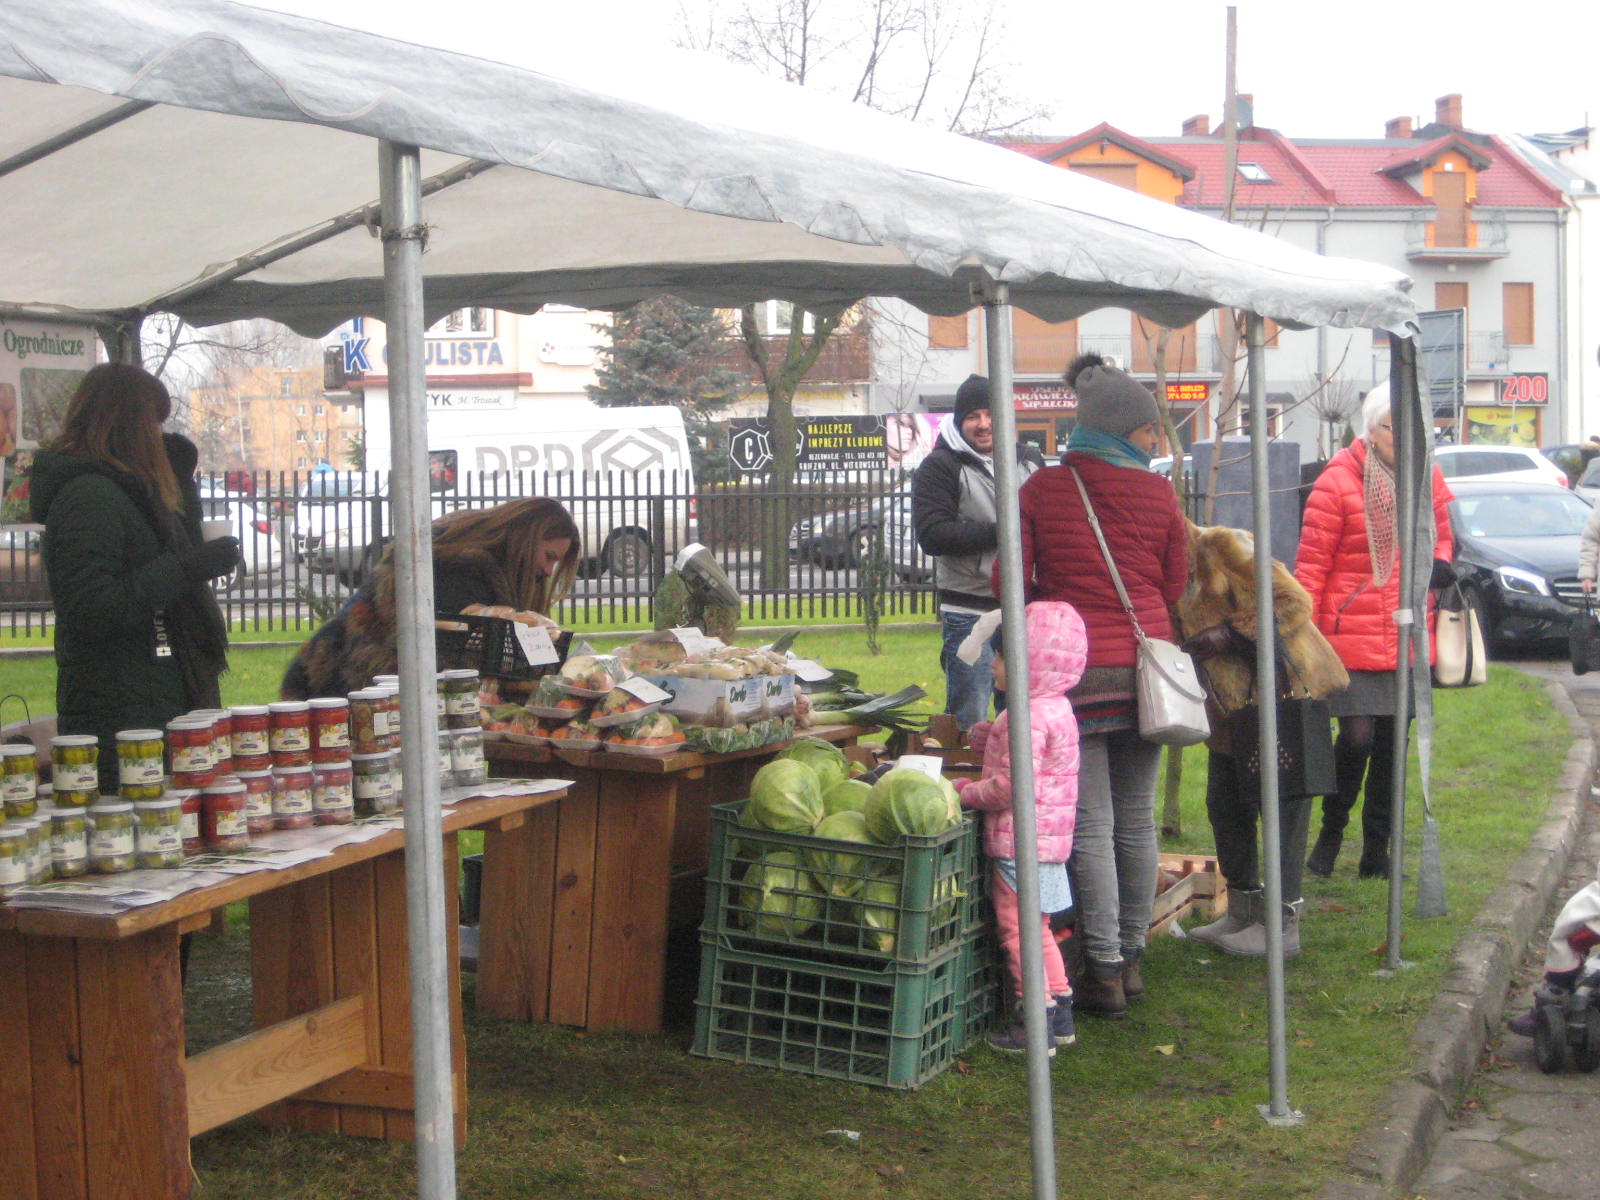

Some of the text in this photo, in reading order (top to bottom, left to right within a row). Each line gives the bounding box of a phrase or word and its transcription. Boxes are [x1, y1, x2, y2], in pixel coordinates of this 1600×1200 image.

[4, 328, 85, 359] Ogrodnicze
[383, 342, 503, 366] ULISTA
[1503, 376, 1547, 401] ZOO
[808, 424, 853, 434] NAJLEPSZE
[808, 436, 884, 448] IMPREZY KLUBOWE
[475, 443, 575, 480] DPD
